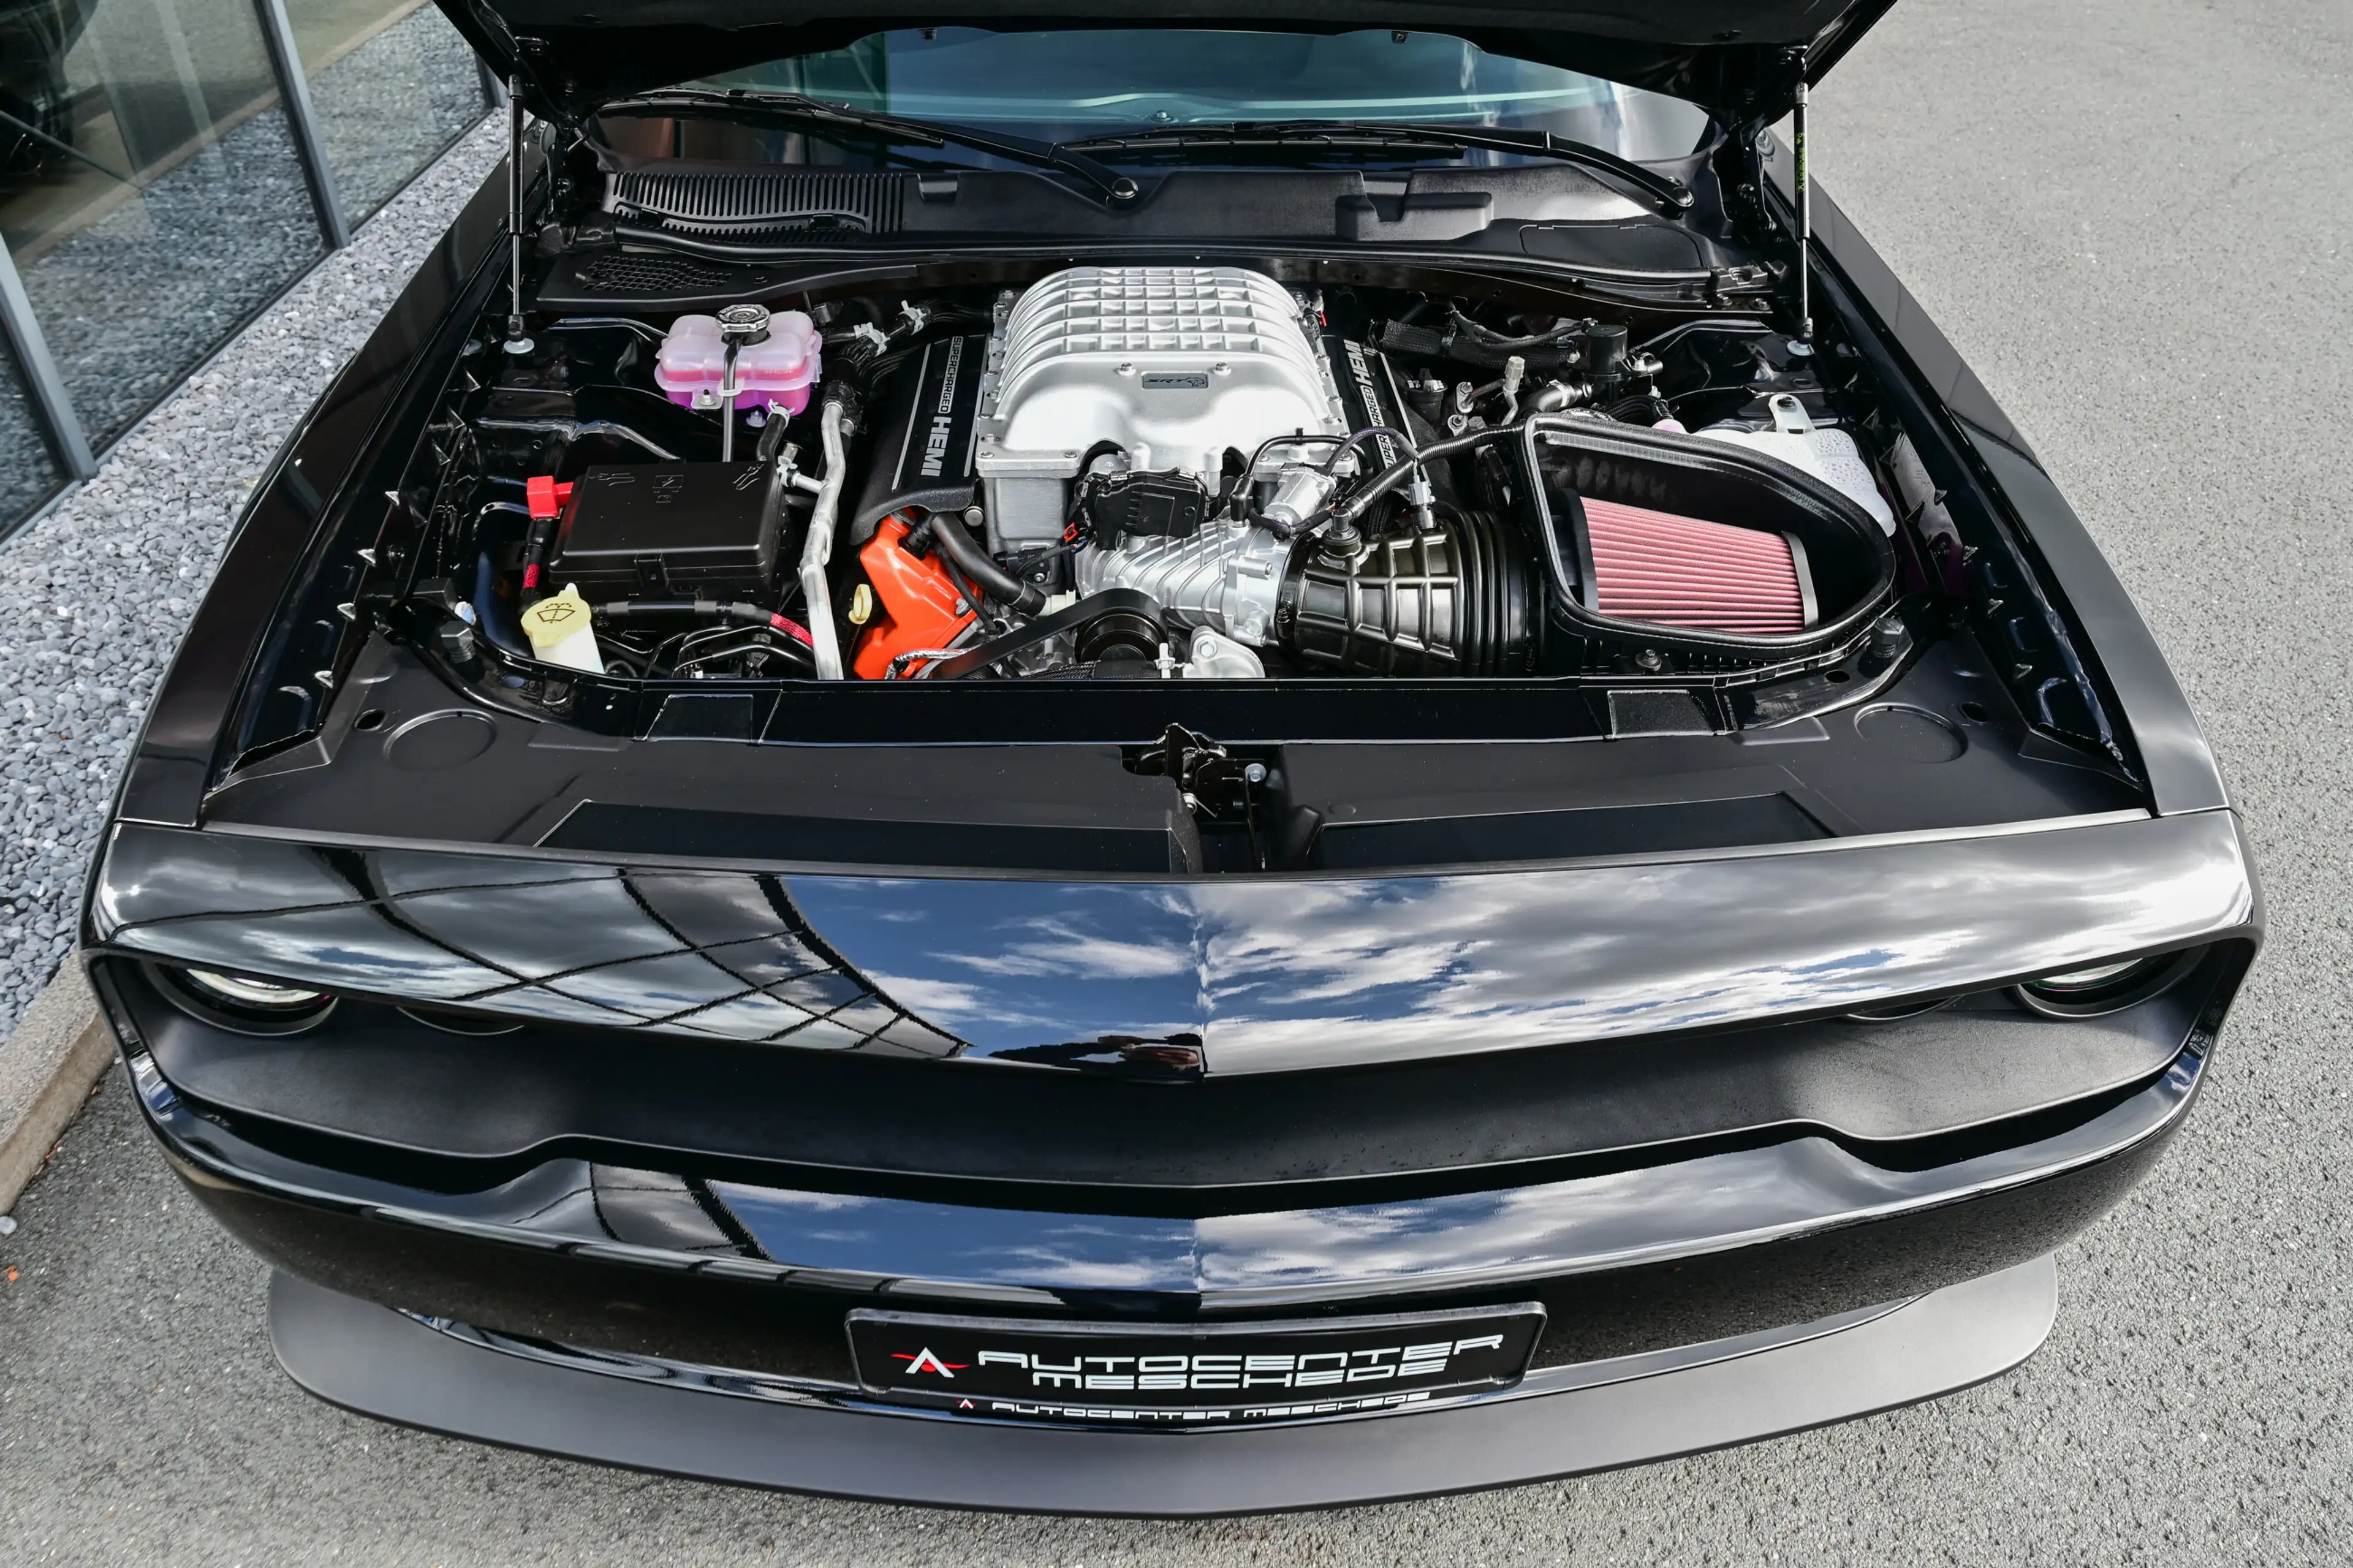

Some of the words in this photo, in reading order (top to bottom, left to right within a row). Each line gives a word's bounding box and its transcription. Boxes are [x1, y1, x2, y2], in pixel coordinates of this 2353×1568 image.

[940, 336, 963, 412] SUPERCHARGED
[1344, 339, 1373, 386] HEMI
[920, 416, 952, 477] HEMI
[1362, 387, 1395, 468] UPERHARGED
[979, 1335, 1503, 1373] AUTOCENTER
[1033, 1358, 1447, 1390] MESCHEDE
